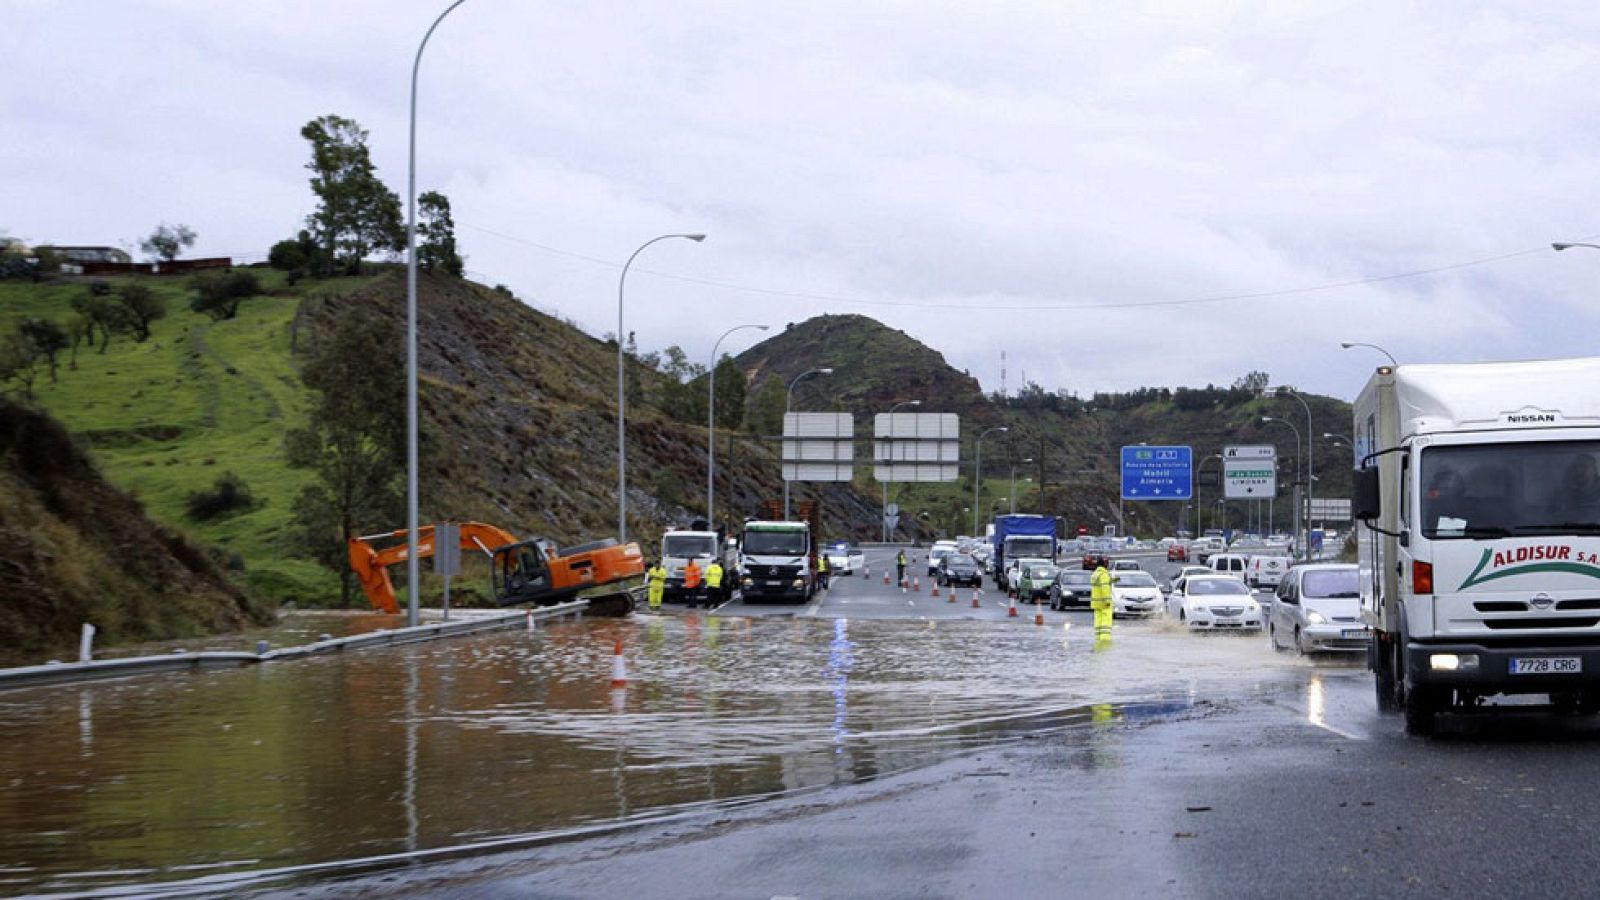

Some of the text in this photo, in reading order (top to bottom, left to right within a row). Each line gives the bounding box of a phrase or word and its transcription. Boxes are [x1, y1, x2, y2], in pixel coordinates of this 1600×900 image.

[1507, 414, 1554, 423] NISSAN
[1493, 545, 1571, 568] ALDISUR
[1519, 659, 1577, 672] 7728 CRG
